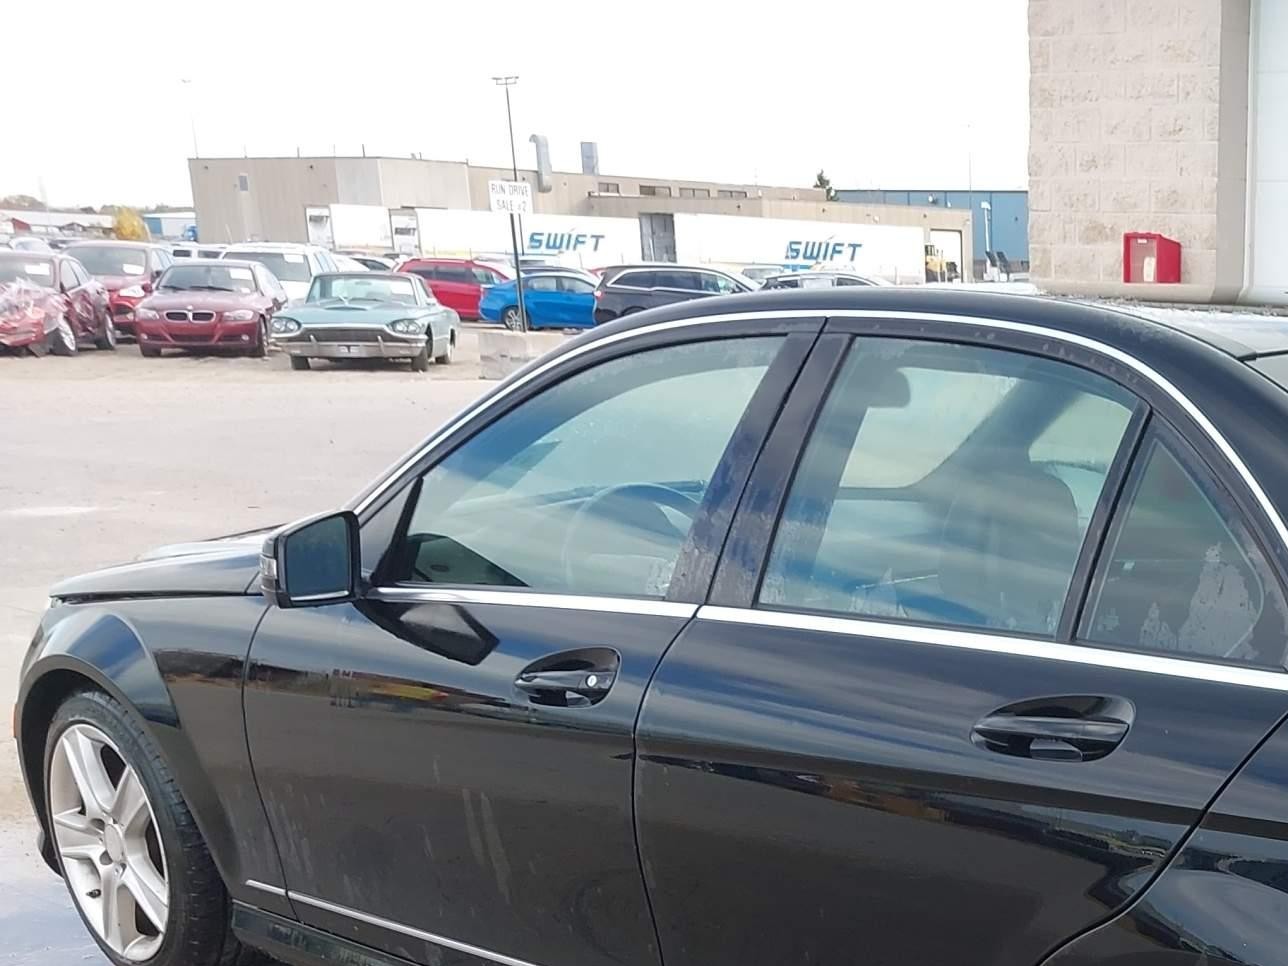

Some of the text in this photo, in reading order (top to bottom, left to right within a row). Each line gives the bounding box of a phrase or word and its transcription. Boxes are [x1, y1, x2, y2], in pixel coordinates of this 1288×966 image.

[491, 183, 529, 197] RUN DRIVE
[496, 199, 514, 212] SALE
[528, 232, 606, 252] SWIFT
[788, 240, 863, 262] SWIFT
